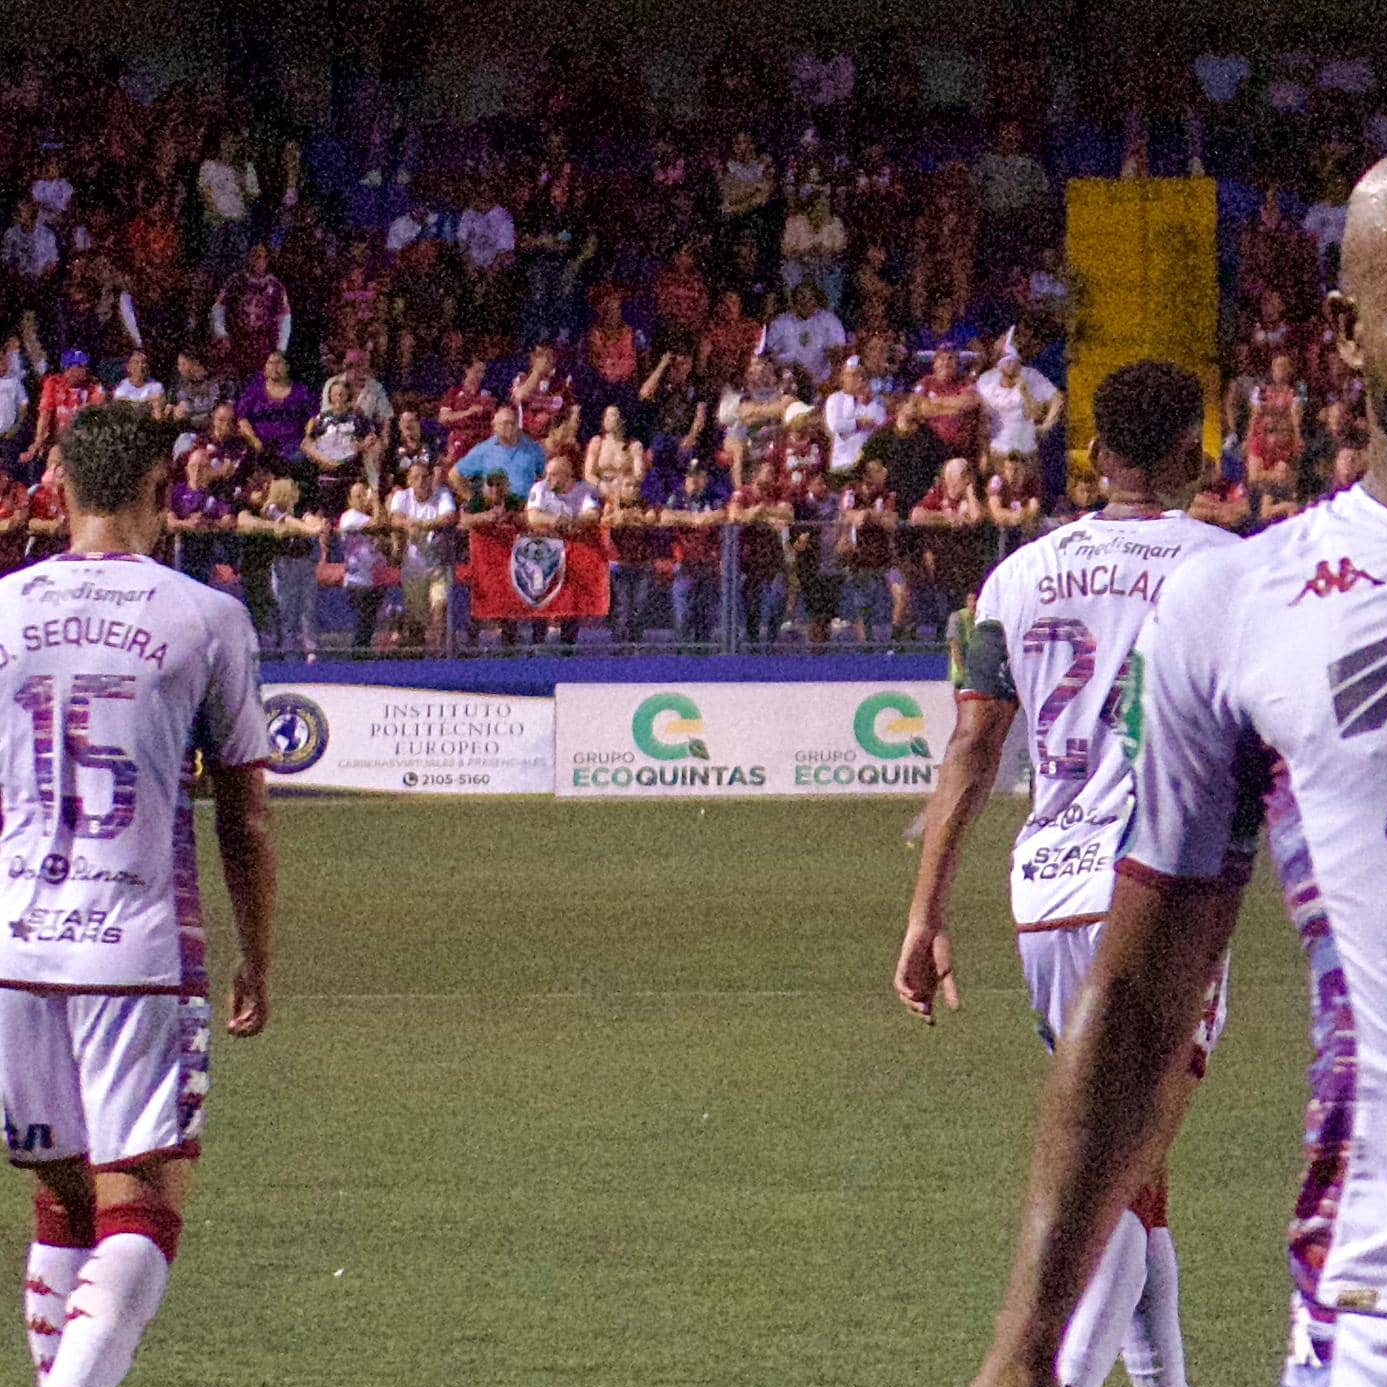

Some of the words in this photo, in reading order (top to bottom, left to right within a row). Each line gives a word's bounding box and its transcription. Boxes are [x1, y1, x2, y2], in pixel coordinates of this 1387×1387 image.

[1075, 536, 1182, 561] medismart
[1038, 564, 1165, 606] SINCLAI
[23, 616, 168, 670] SEQUEIRA
[384, 704, 512, 719] INSTITUTO
[14, 674, 138, 839] 15
[395, 740, 500, 756] EUROPEO
[573, 751, 635, 764] GRUPO
[794, 750, 857, 763] GRUPO
[572, 766, 766, 787] ECOQUINTAS
[794, 763, 940, 786] ECOQUIN
[1034, 843, 1101, 864] STAR
[28, 908, 108, 925] STAR
[37, 926, 123, 943] CARS
